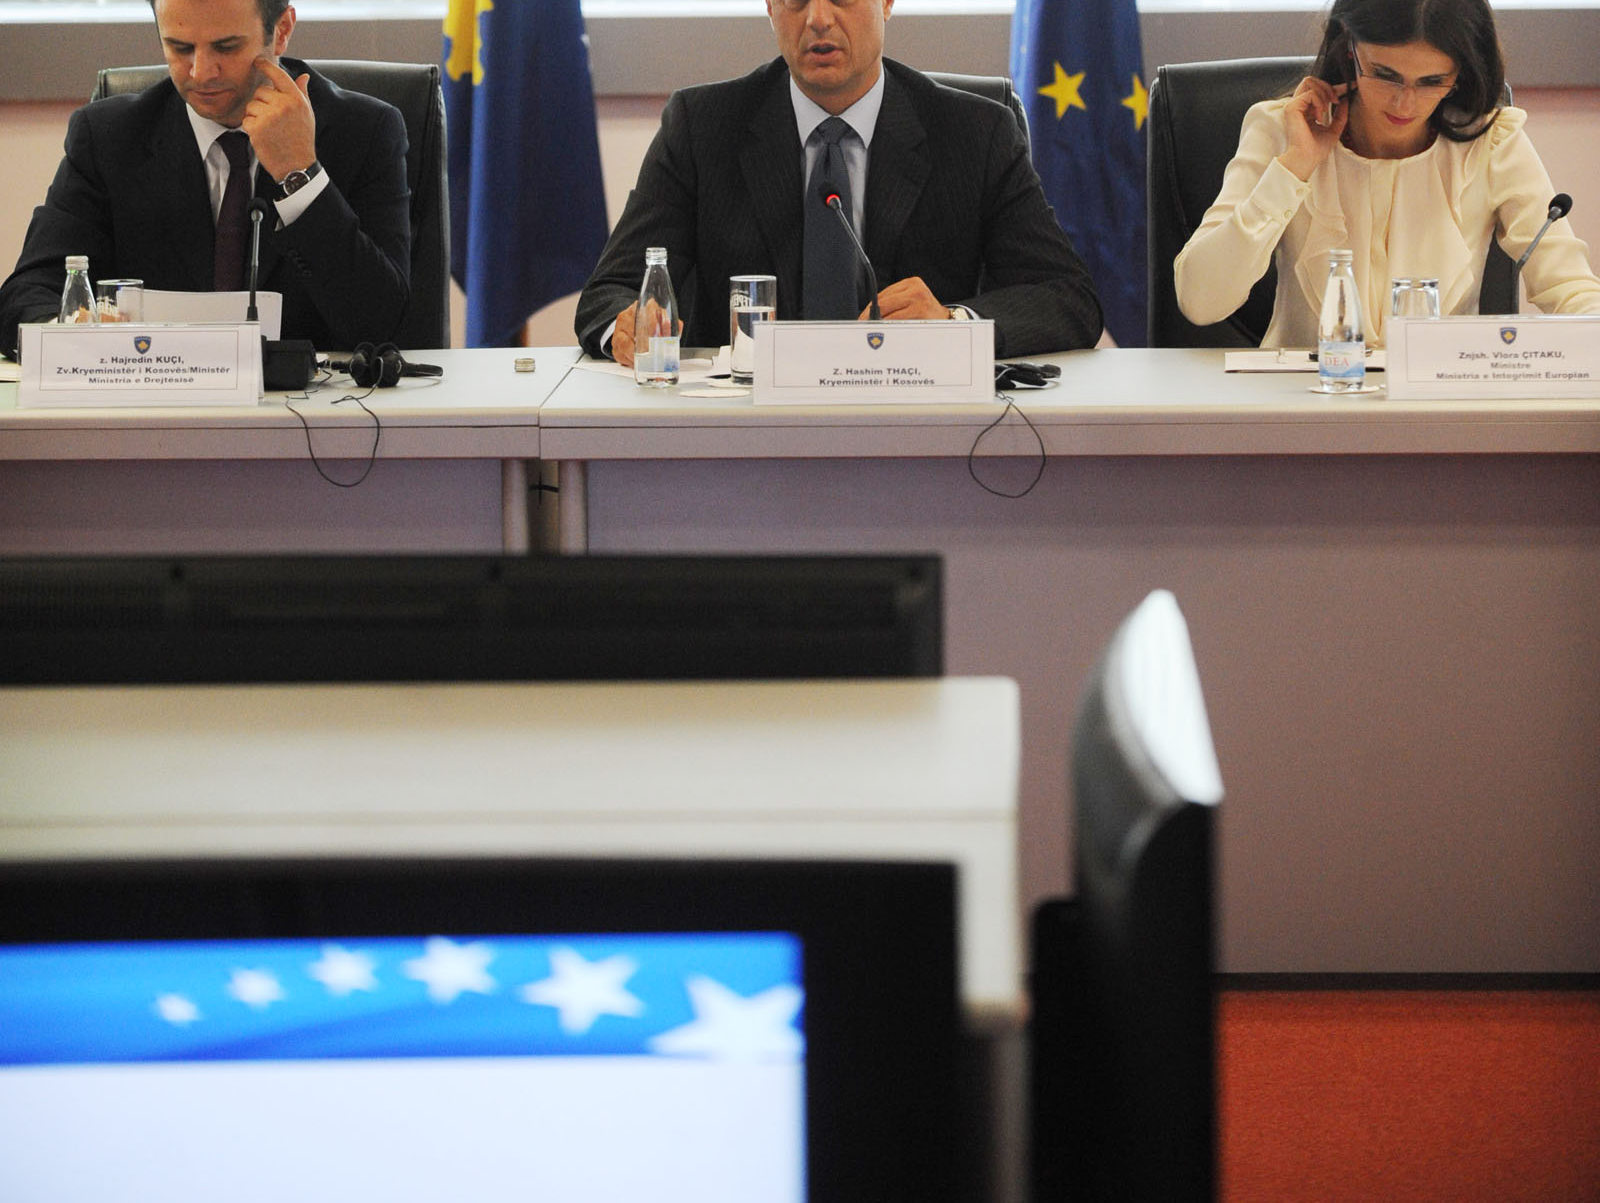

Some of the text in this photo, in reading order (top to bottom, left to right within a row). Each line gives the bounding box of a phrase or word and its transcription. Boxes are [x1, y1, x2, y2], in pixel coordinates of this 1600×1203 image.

[1491, 351, 1520, 359] Vlora
[1522, 350, 1565, 360] ÇITAKU,
[111, 356, 153, 366] Hajredin
[155, 355, 185, 365] KUÇI,
[1324, 357, 1350, 367] DEA
[832, 367, 921, 376] Z. Hashim THAÇI,
[1544, 371, 1590, 380] Europian
[819, 378, 883, 387] Kryeministër
[892, 378, 935, 386] Kosovës
